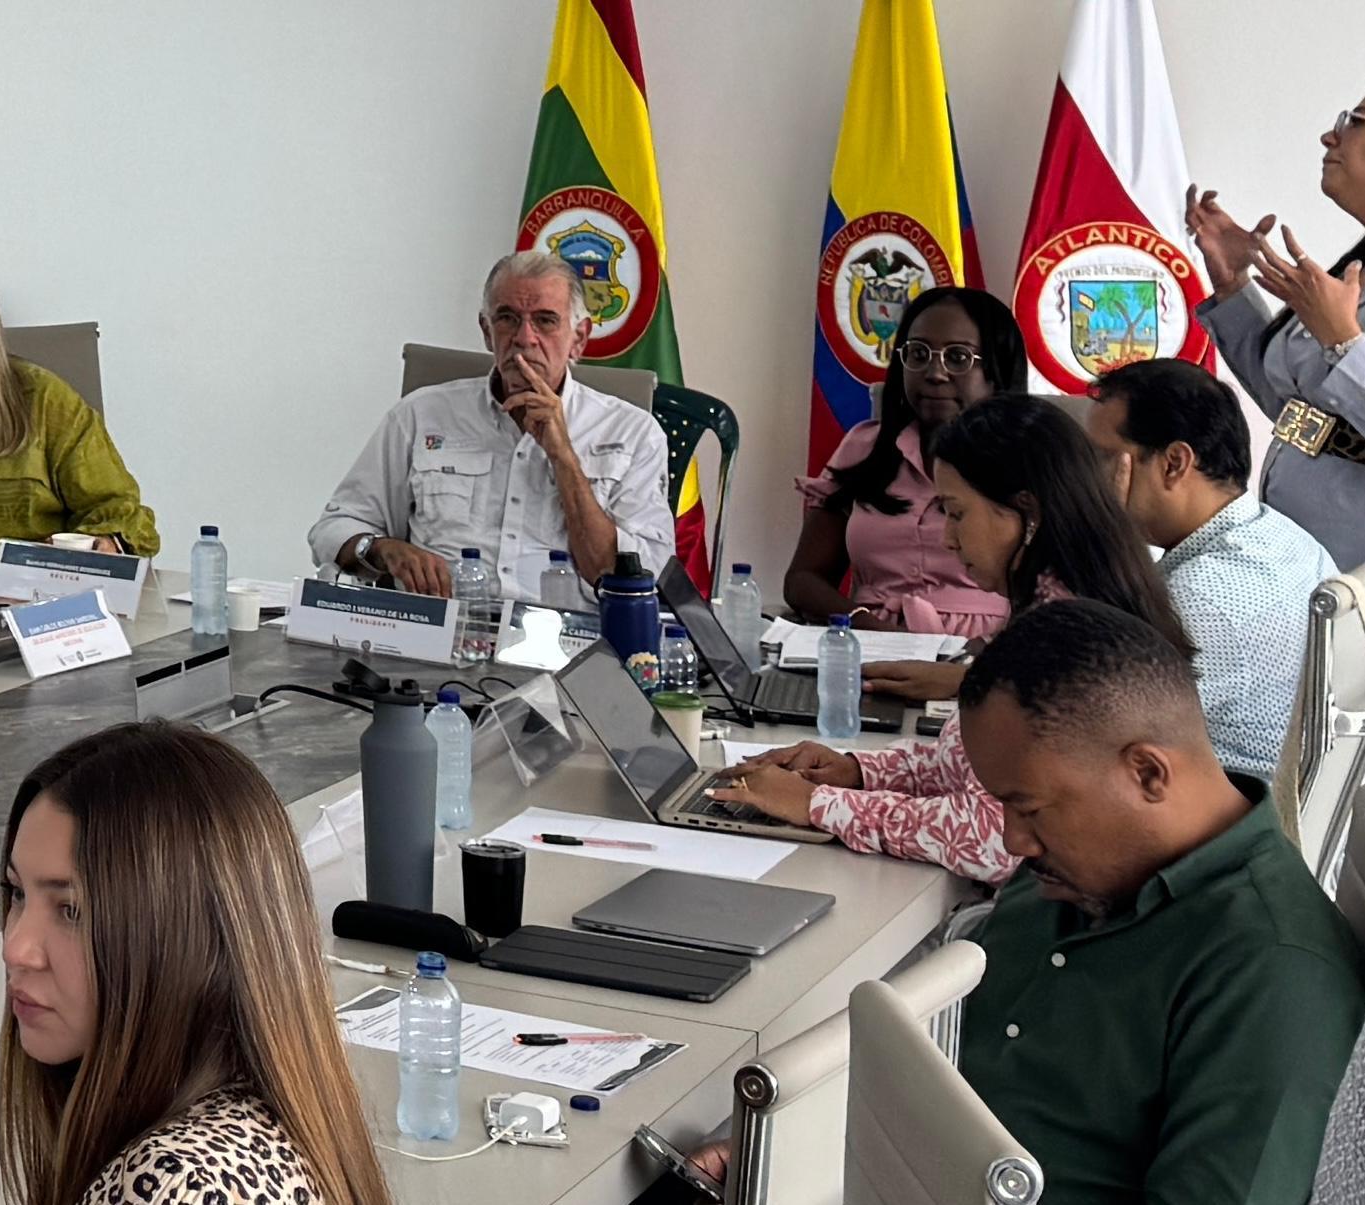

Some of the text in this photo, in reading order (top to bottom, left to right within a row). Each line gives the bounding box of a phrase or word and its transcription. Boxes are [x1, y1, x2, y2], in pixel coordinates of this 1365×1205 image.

[525, 191, 645, 241] BARRANQUILLA
[819, 214, 952, 289] REPUBLICA DE COLOMBI
[1035, 226, 1190, 279] ATLANTICO
[349, 616, 396, 629] PRESIDENTE
[399, 611, 408, 620] LA
[409, 613, 430, 623] ROSA
